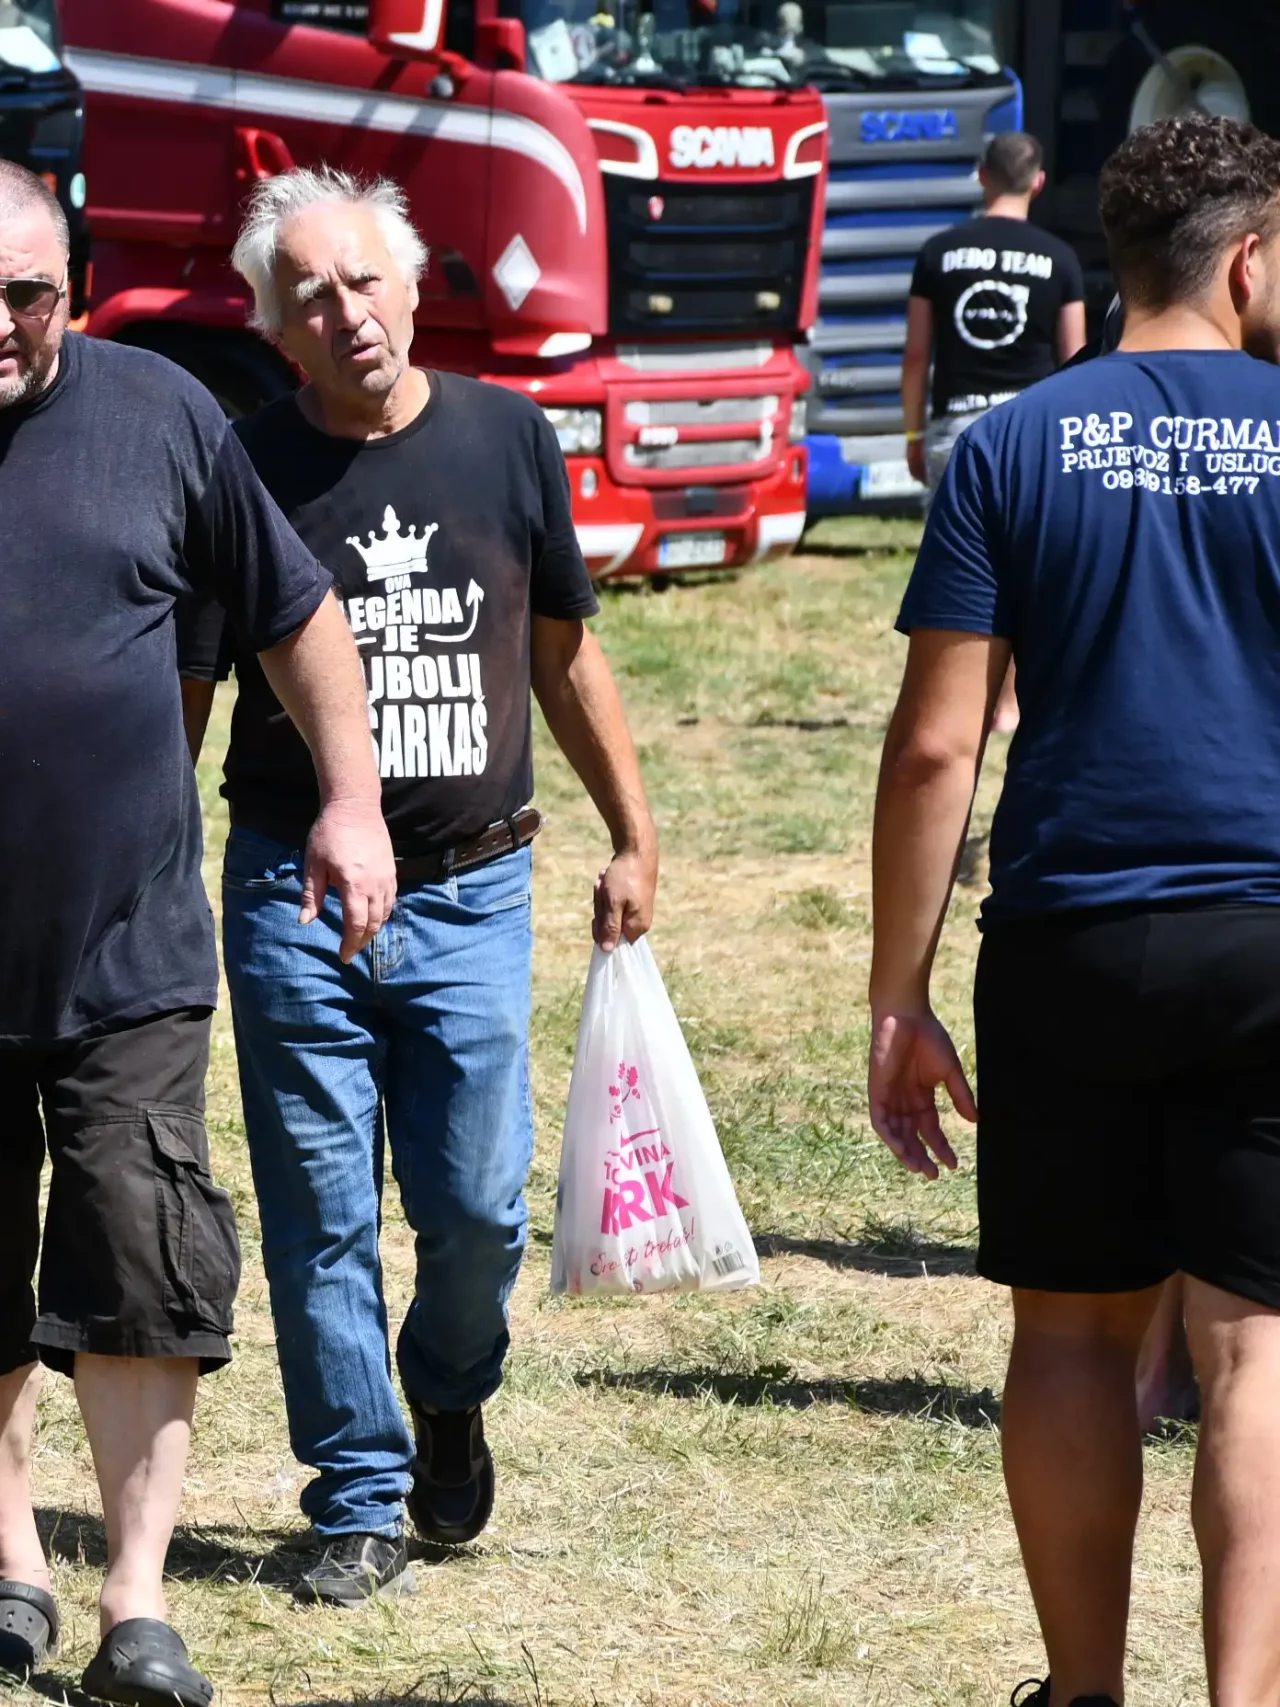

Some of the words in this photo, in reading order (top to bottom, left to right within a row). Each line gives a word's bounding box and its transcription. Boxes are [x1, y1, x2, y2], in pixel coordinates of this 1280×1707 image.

[860, 109, 958, 142] SCANIA
[669, 125, 774, 168] SCANIA
[1001, 249, 1053, 280] TEAM
[1059, 411, 1133, 450] P&P
[1150, 415, 1280, 453] CURMA
[1062, 444, 1170, 473] PRIJEVOZ
[1179, 452, 1190, 472] I
[385, 574, 412, 594] OVA
[339, 588, 464, 633] EGENDA
[382, 625, 419, 652] JE
[360, 653, 483, 700] JBOLJI
[601, 1161, 689, 1237] KRK
